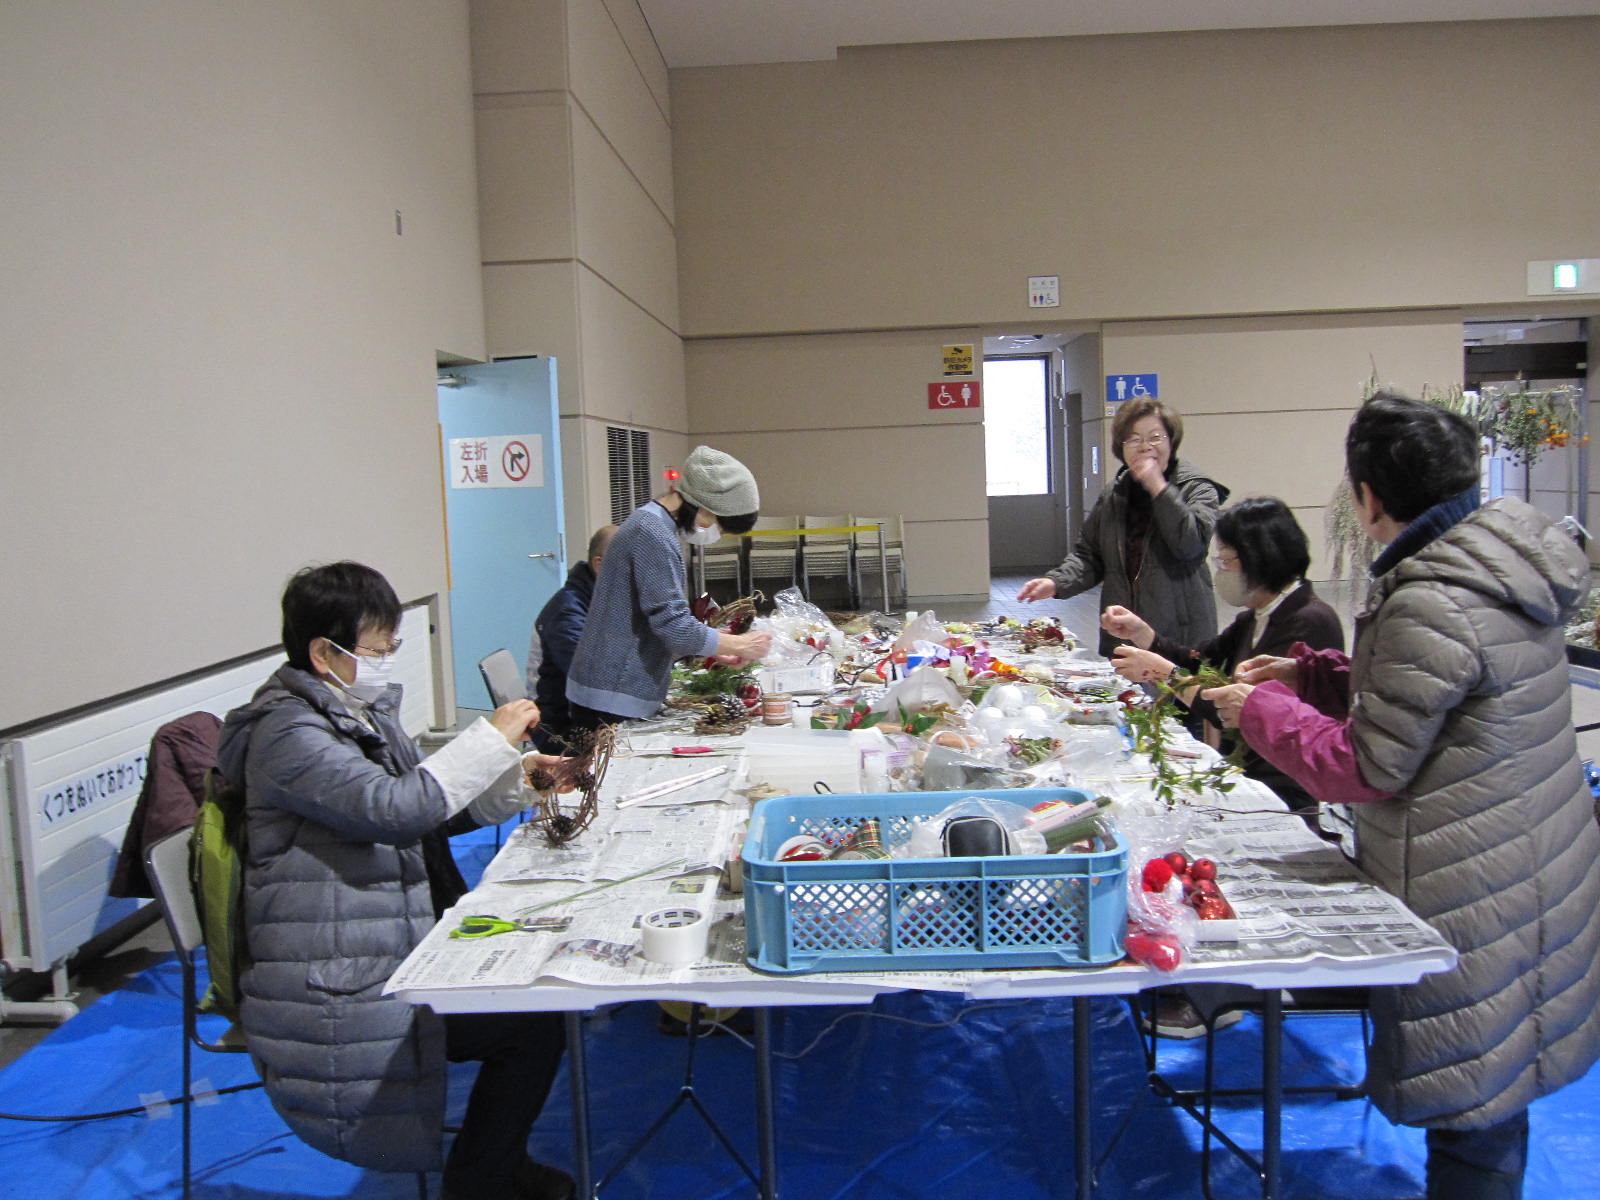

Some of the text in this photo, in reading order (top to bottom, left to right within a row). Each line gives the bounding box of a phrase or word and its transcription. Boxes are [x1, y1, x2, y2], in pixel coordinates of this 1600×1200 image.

[460, 440, 488, 461] 左折
[460, 464, 489, 484] 入場
[43, 751, 148, 822] くつをぬいであがって
